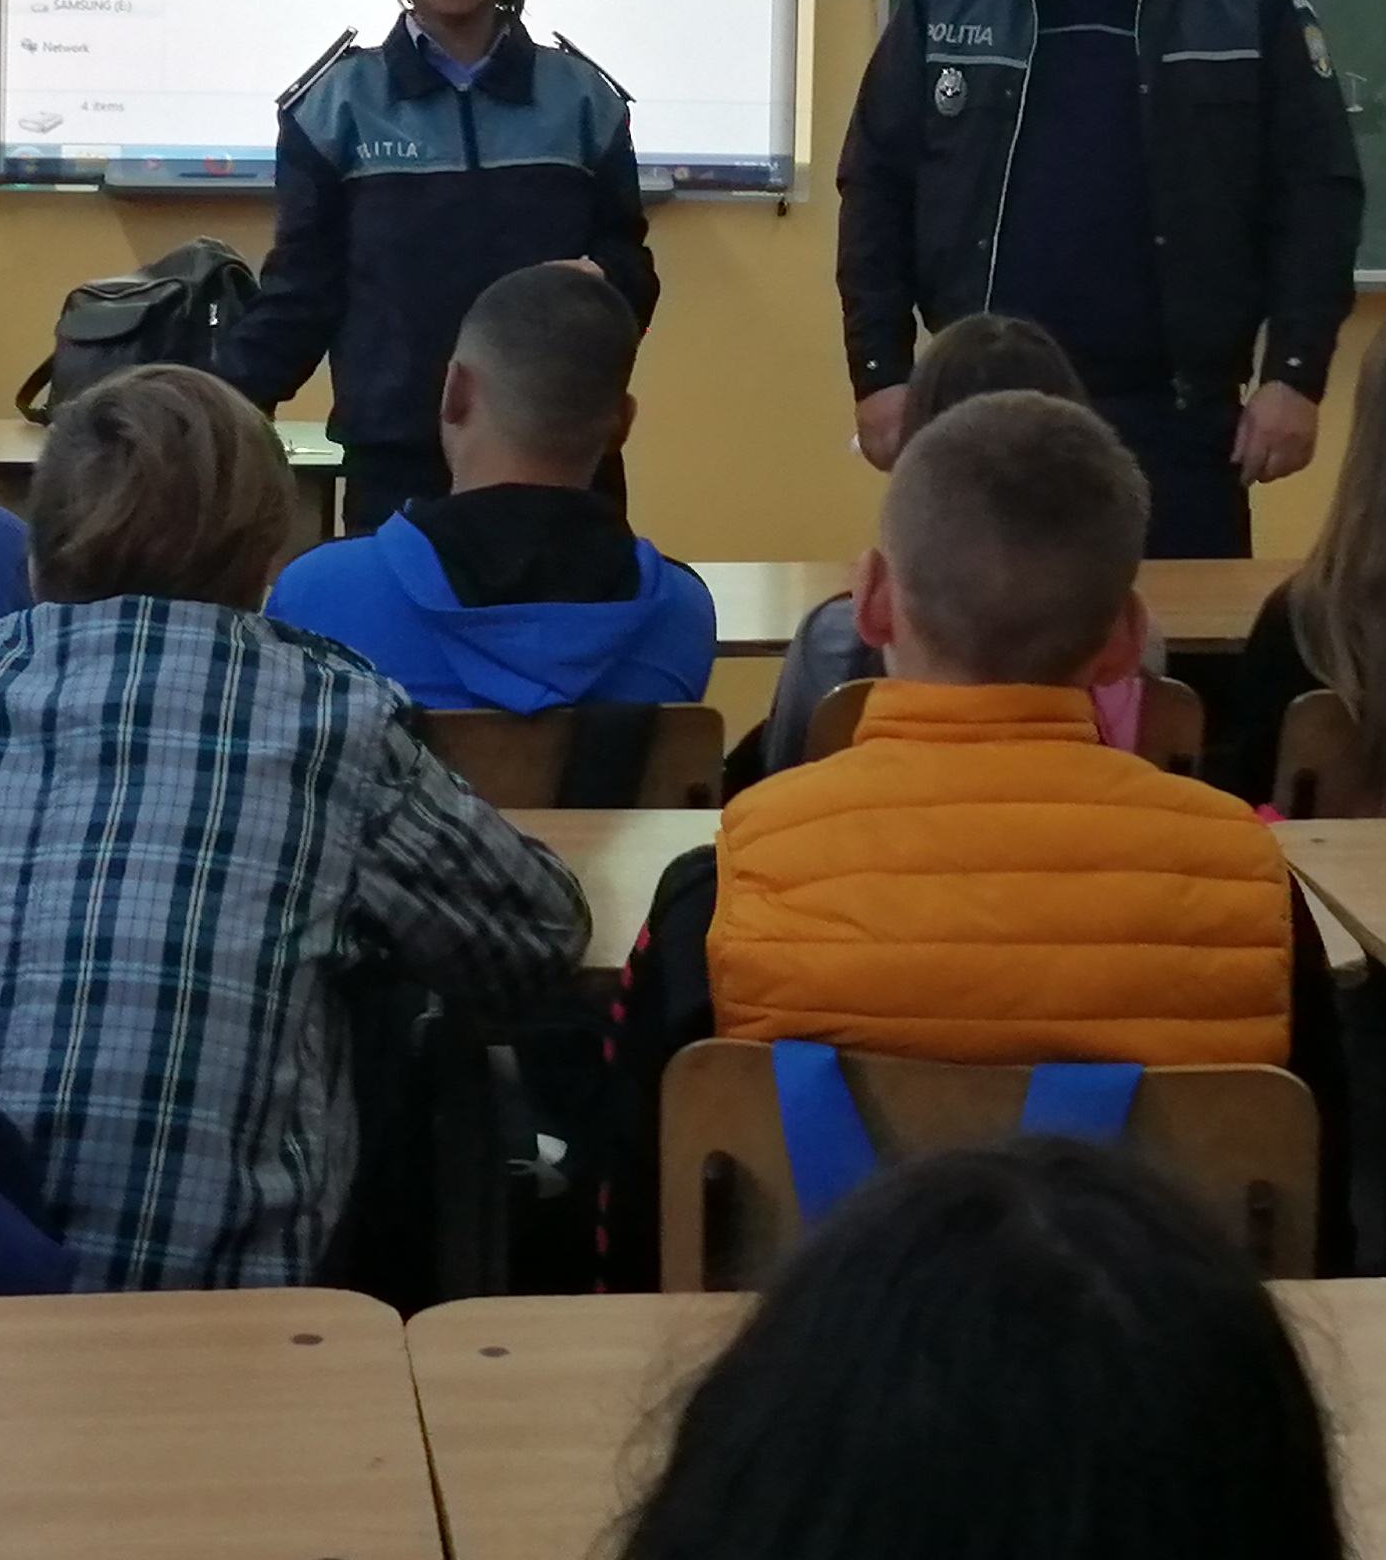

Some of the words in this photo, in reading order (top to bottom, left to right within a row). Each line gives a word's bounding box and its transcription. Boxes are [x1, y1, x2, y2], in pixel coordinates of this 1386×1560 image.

[53, 0, 112, 12] SAMSUNG
[114, 0, 132, 14] (E:)
[43, 42, 90, 54] Network
[92, 100, 125, 112] items
